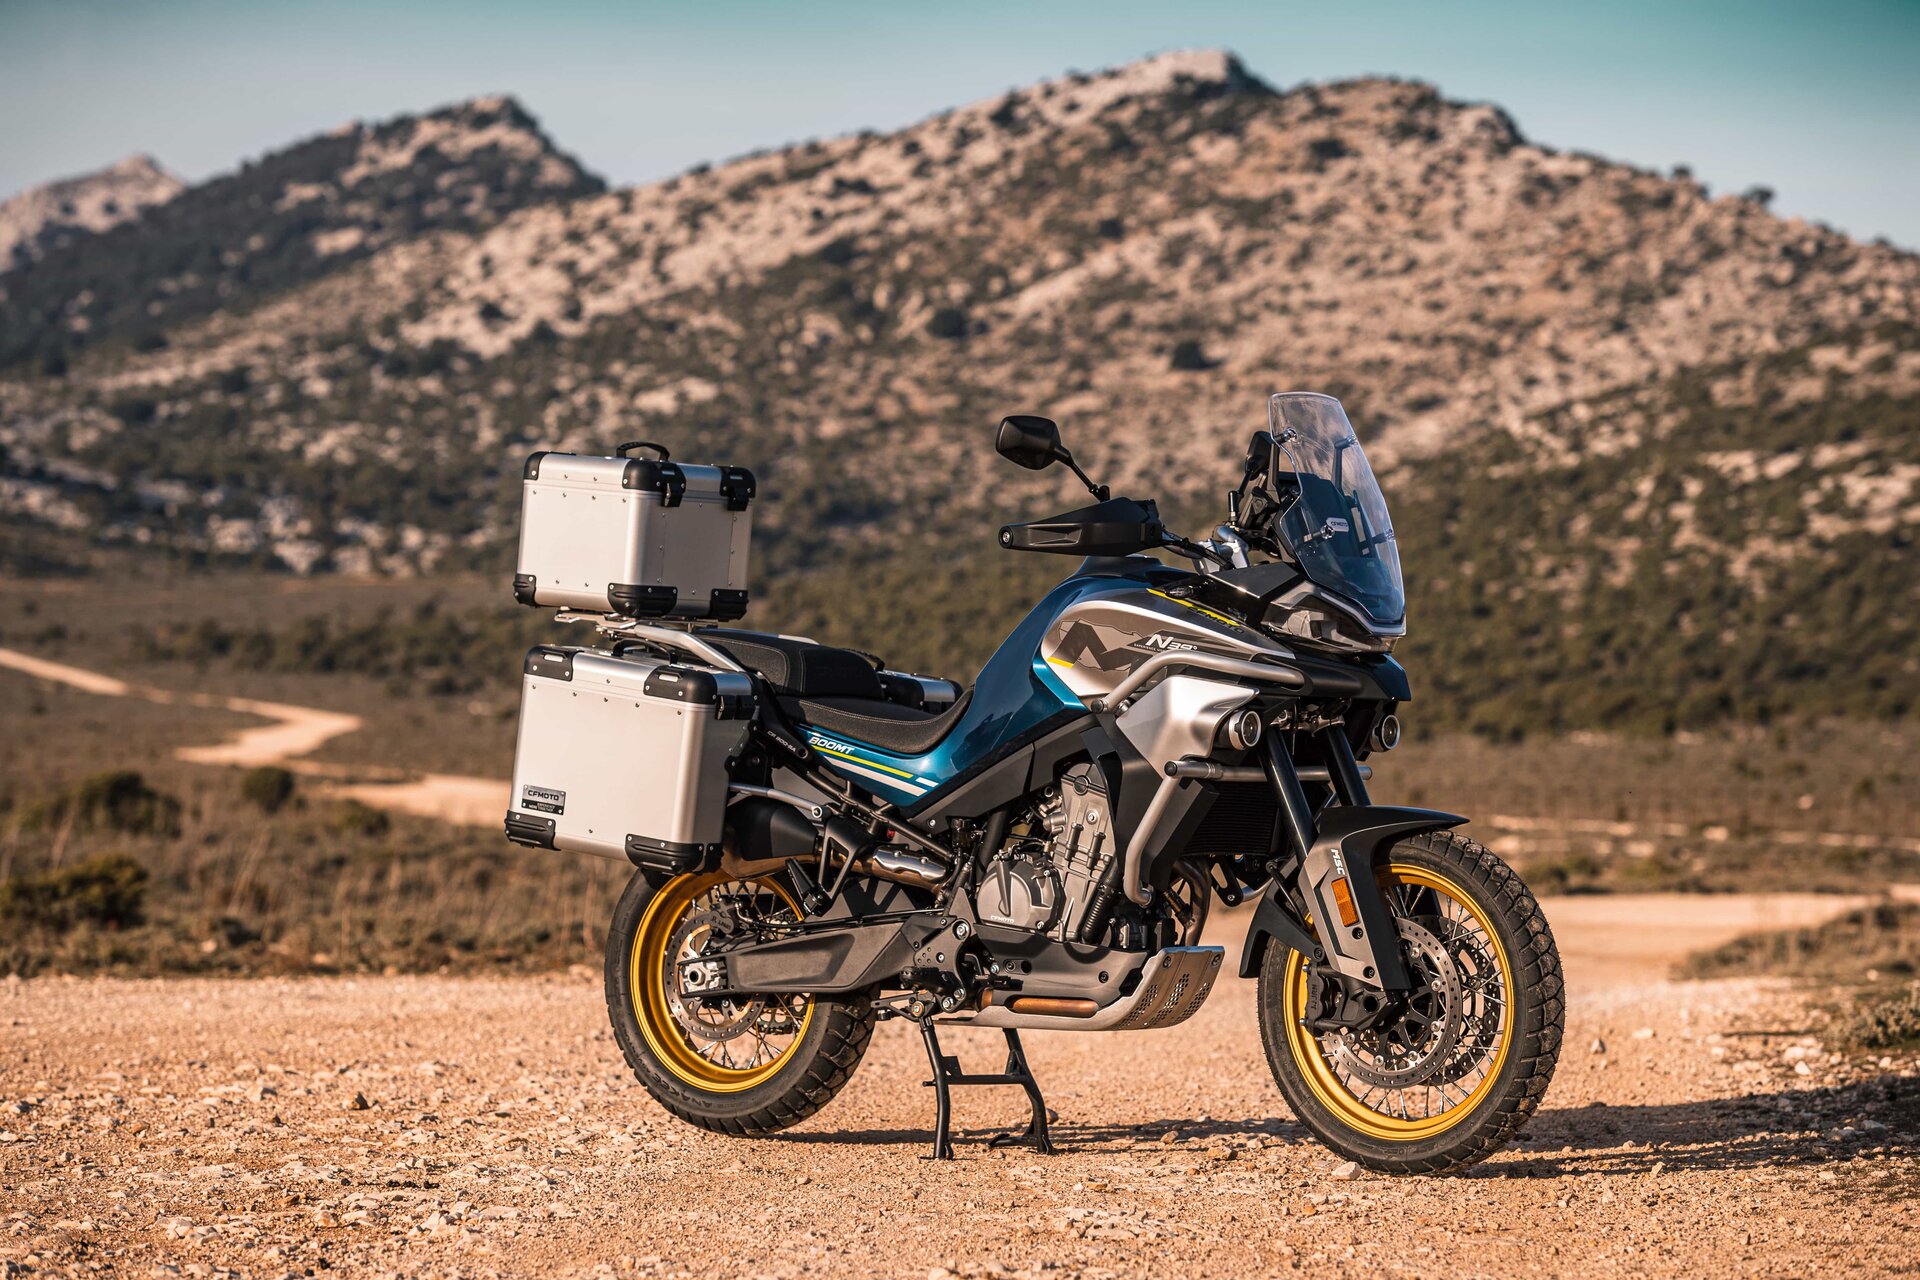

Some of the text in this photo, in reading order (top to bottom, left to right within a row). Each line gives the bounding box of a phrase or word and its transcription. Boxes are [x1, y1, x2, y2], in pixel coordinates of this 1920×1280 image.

[1187, 606, 1245, 634] CFMOTO
[809, 736, 855, 754] 800MT
[527, 790, 559, 801] CFMOTO
[1330, 848, 1345, 875] MSC
[651, 1073, 713, 1108] ANAKEE
